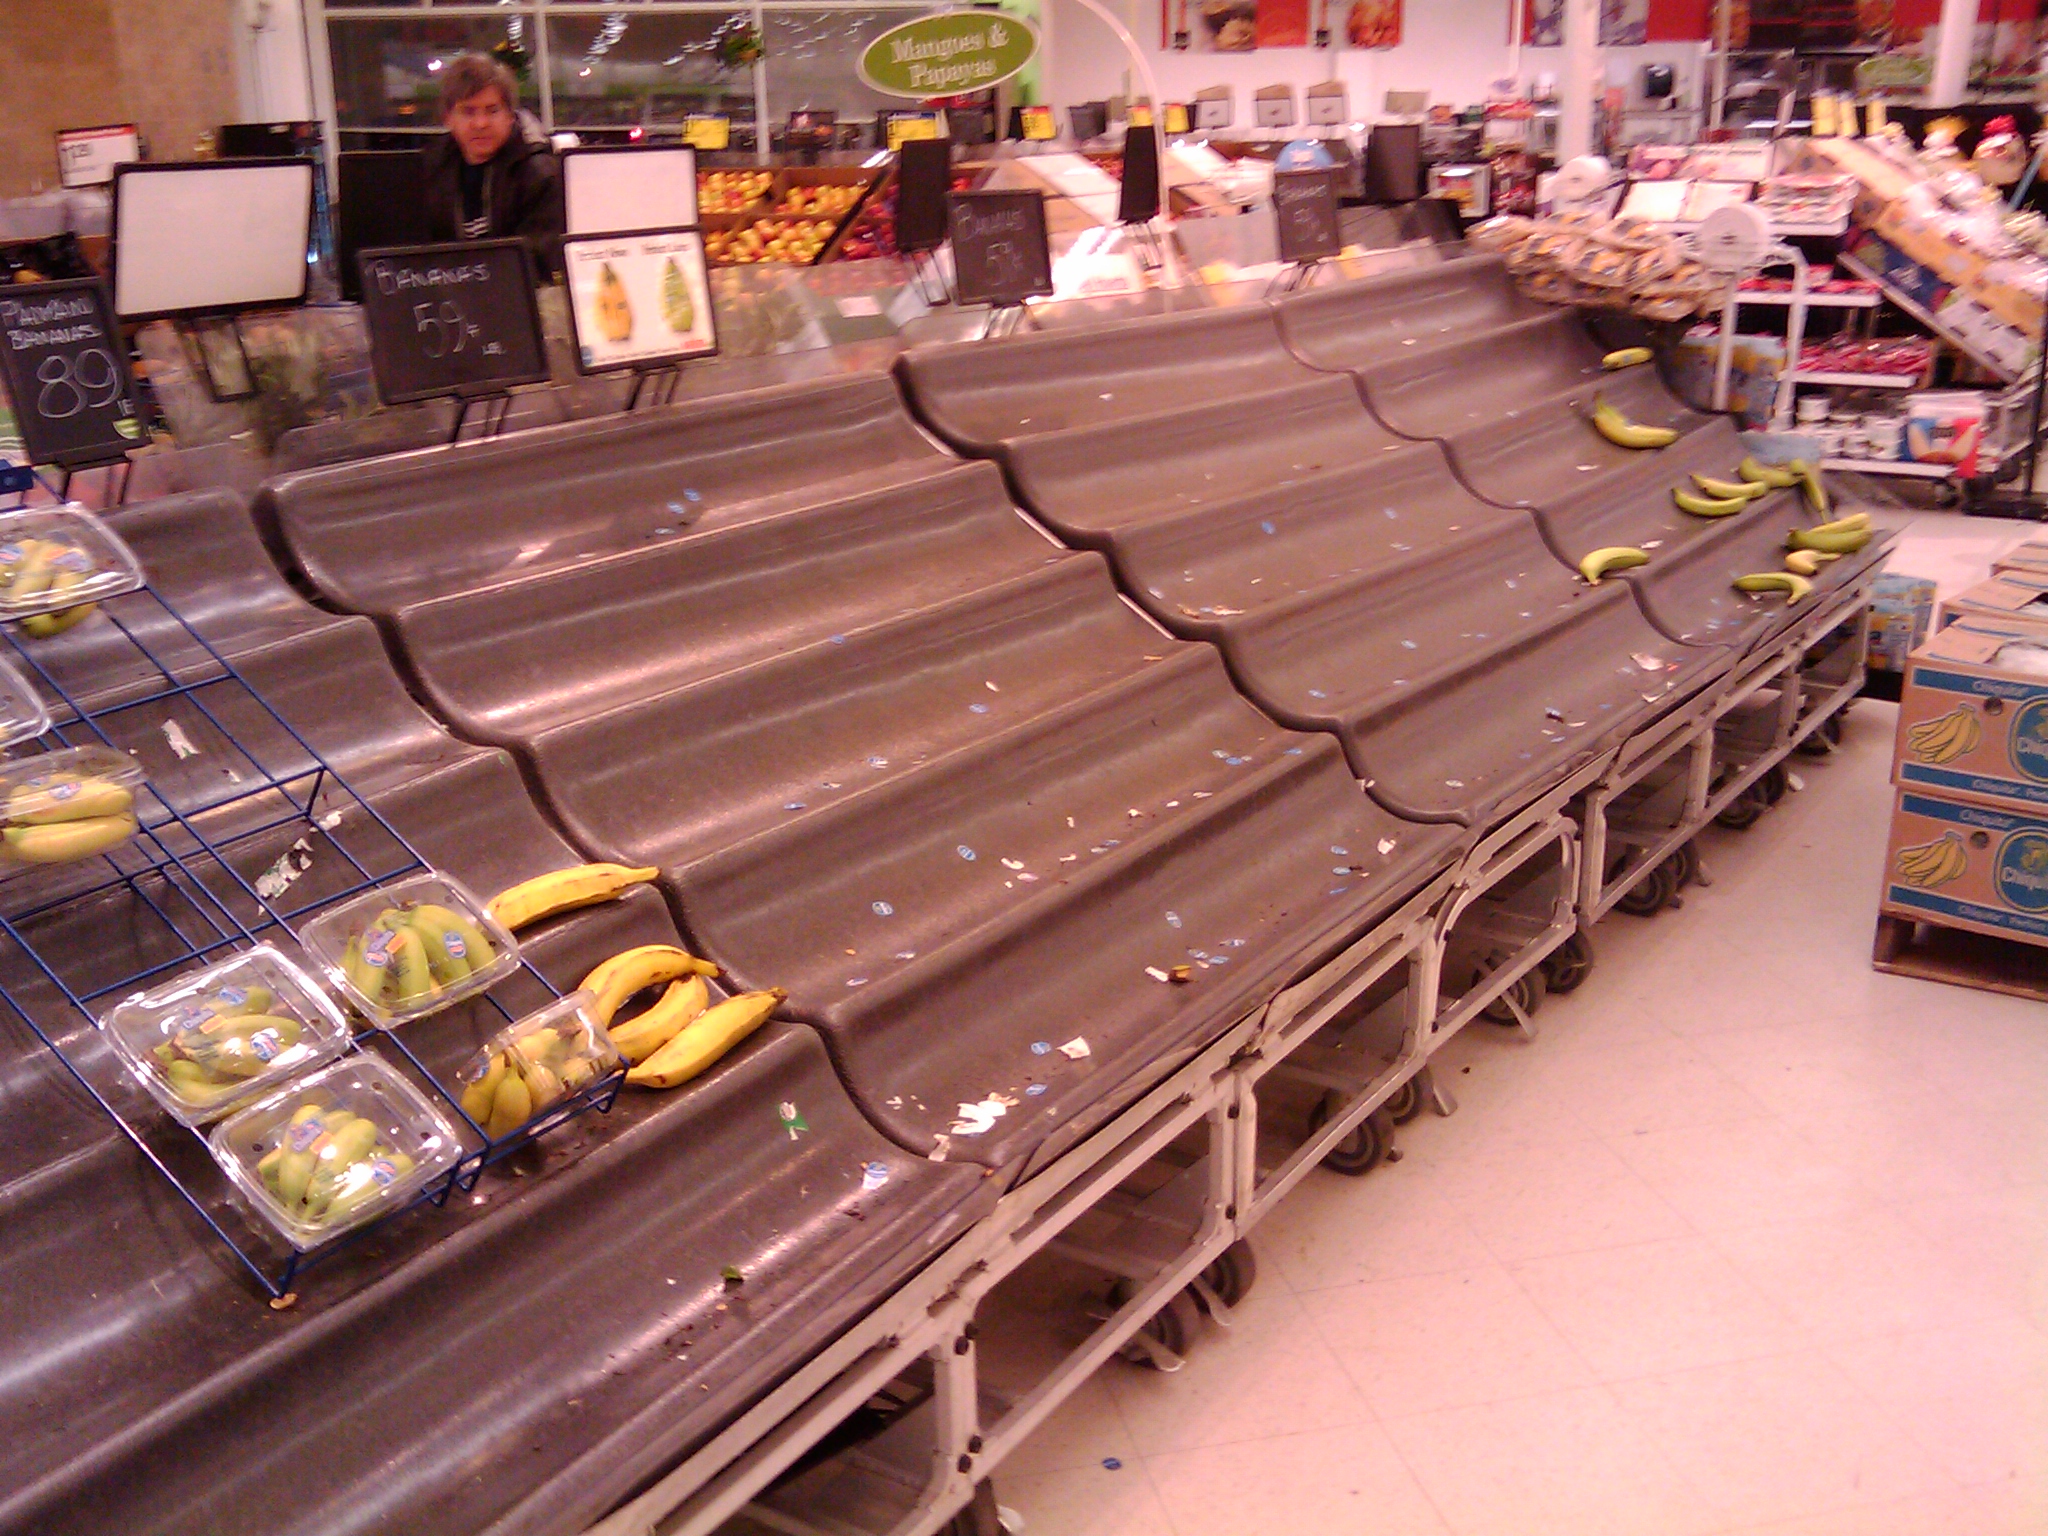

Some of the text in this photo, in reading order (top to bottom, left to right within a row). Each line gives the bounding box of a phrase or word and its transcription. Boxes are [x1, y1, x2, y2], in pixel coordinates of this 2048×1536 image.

[987, 22, 1010, 49] &
[907, 58, 997, 90] Papayas
[36, 348, 124, 418] 89
